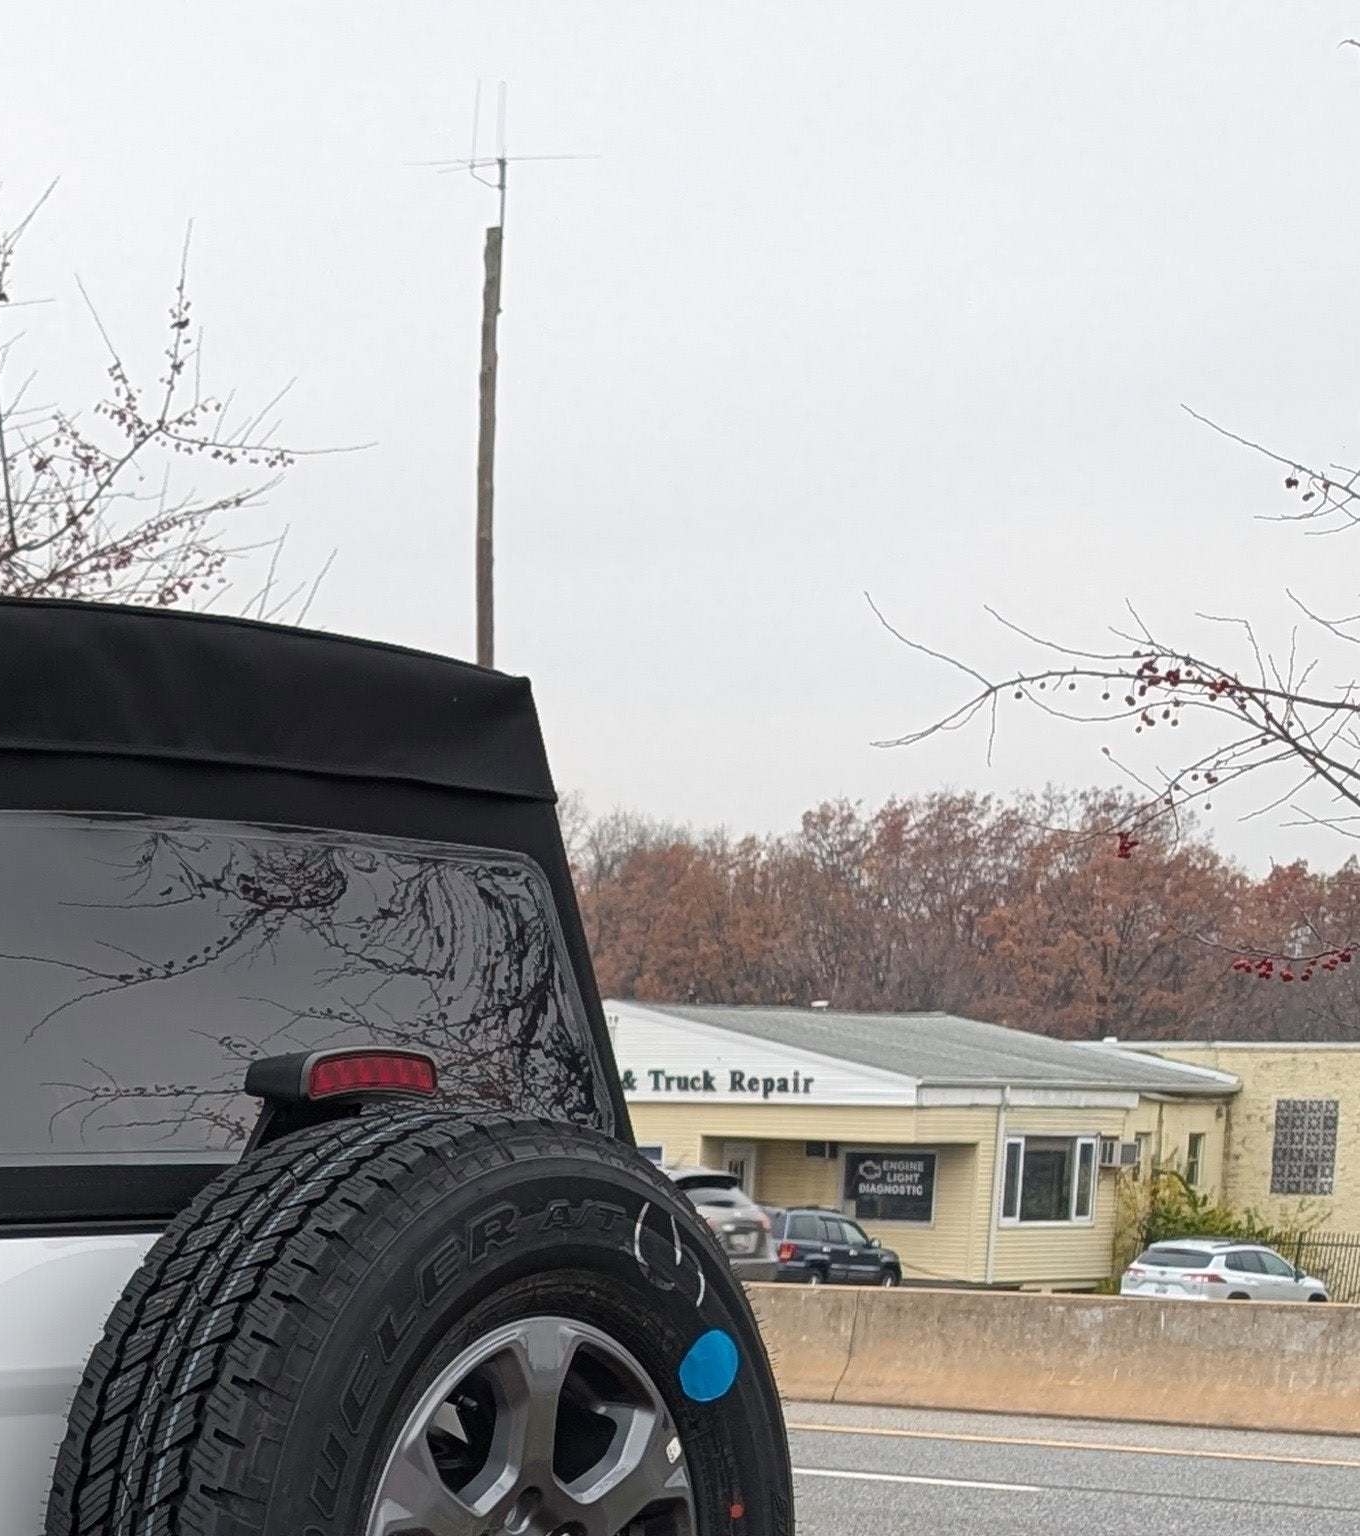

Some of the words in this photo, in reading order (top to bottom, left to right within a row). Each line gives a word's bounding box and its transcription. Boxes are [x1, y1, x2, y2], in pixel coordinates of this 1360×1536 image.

[620, 1068, 638, 1092] &
[647, 1068, 717, 1093] Truck
[728, 1068, 815, 1100] Repair
[882, 1159, 925, 1173] ENGINE
[885, 1171, 921, 1184] LIGHT
[858, 1182, 924, 1197] DIAGNOSTIC
